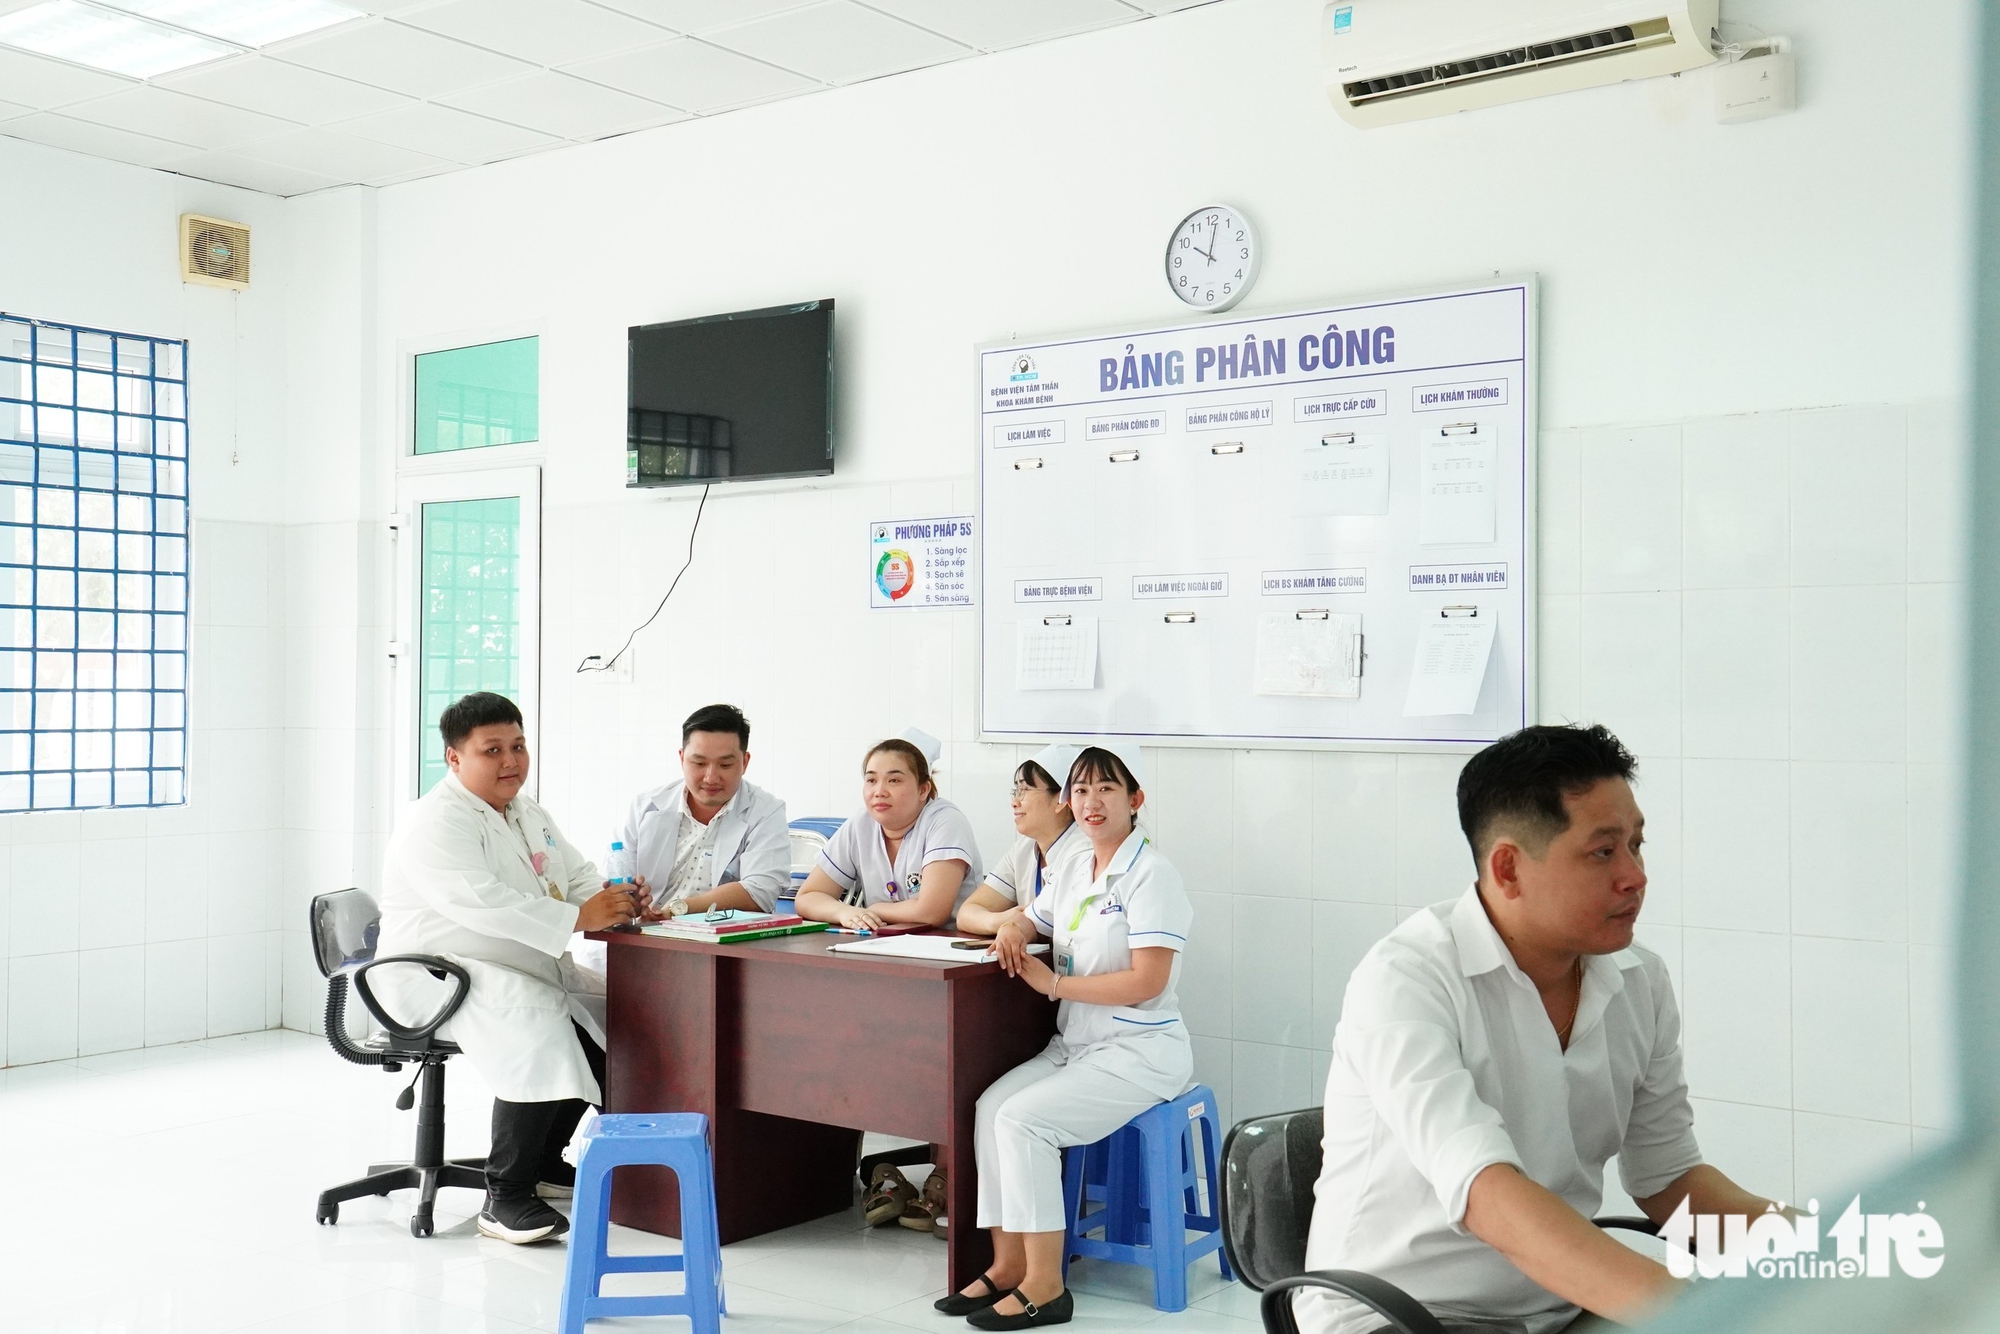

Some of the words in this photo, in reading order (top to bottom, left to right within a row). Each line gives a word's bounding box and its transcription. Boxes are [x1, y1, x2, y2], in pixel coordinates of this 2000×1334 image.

[1338, 65, 1357, 74] Reetech
[1206, 214, 1219, 226] 12
[1226, 218, 1230, 228] 1
[1190, 222, 1201, 234] 11
[1236, 230, 1244, 241] 2
[1179, 237, 1191, 249] 10
[1240, 248, 1249, 259] 3
[1174, 257, 1182, 268] 9
[1235, 268, 1243, 280] 4
[1179, 276, 1187, 287] 8
[1191, 286, 1199, 297] 7
[1223, 283, 1231, 294] 5
[1206, 290, 1215, 301] 6
[1100, 343, 1184, 392] BẢNG
[1196, 334, 1286, 383] PHÂN
[1299, 324, 1395, 372] CÔNG
[991, 387, 1008, 397] BỆNH
[1010, 385, 1024, 395] VIỆN
[1026, 383, 1040, 392] TÂM
[1041, 380, 1059, 391] THẦN
[996, 399, 1013, 407] KHOA
[1015, 396, 1034, 405] KHÁM
[1036, 394, 1053, 405] BỆNH
[1421, 393, 1438, 406] LỊCH
[1441, 390, 1464, 402] KHÁM
[1467, 386, 1499, 400] THƯỜNG
[1304, 404, 1320, 416] LỊCH
[1322, 402, 1341, 414] TRỰC
[1343, 398, 1358, 411] CẤP
[1361, 397, 1376, 409] CỨU
[1189, 413, 1207, 425] BẢNG
[1209, 411, 1228, 423] PHÂN
[1230, 410, 1249, 421] CÔNG
[1250, 408, 1260, 421] HỘ
[1262, 407, 1270, 418] LÝ
[1092, 422, 1109, 433] BẢNG
[1111, 420, 1129, 431] PHÂN
[1130, 418, 1149, 430] CÔNG
[1007, 432, 1021, 442] LỊCH
[1022, 429, 1036, 439] LÀM
[1037, 427, 1051, 440] VIỆC
[895, 524, 931, 540] PHƯƠNG
[933, 521, 957, 537] PHÁP
[960, 522, 972, 536] 5S
[934, 547, 954, 556] Sàng
[955, 546, 968, 555] lọc
[891, 563, 900, 571] 5S
[951, 557, 965, 568] xếp
[926, 571, 933, 579] 3.
[934, 571, 955, 581] Sạch
[1412, 574, 1433, 584] DANH
[1436, 574, 1447, 586] BẠ
[1449, 573, 1459, 583] ĐT
[1461, 571, 1483, 583] NHÂN
[1486, 570, 1505, 582] VIÊN
[951, 582, 964, 590] sóc
[1138, 584, 1153, 594] LỊCH
[1155, 582, 1169, 592] LÀM
[1171, 581, 1186, 593] VIỆC
[1188, 580, 1209, 591] NGOÀI
[1210, 579, 1222, 590] GIỜ
[1264, 579, 1280, 591] LỊCH
[1281, 579, 1292, 588] BS
[1293, 577, 1315, 588] KHÁM
[1317, 576, 1336, 587] TĂNG
[1338, 575, 1364, 586] CƯỜNG
[1024, 585, 1041, 596] BẢNG
[1042, 587, 1058, 597] TRỰC
[1060, 585, 1076, 597] BỆNH
[1078, 584, 1093, 596] VIỆN
